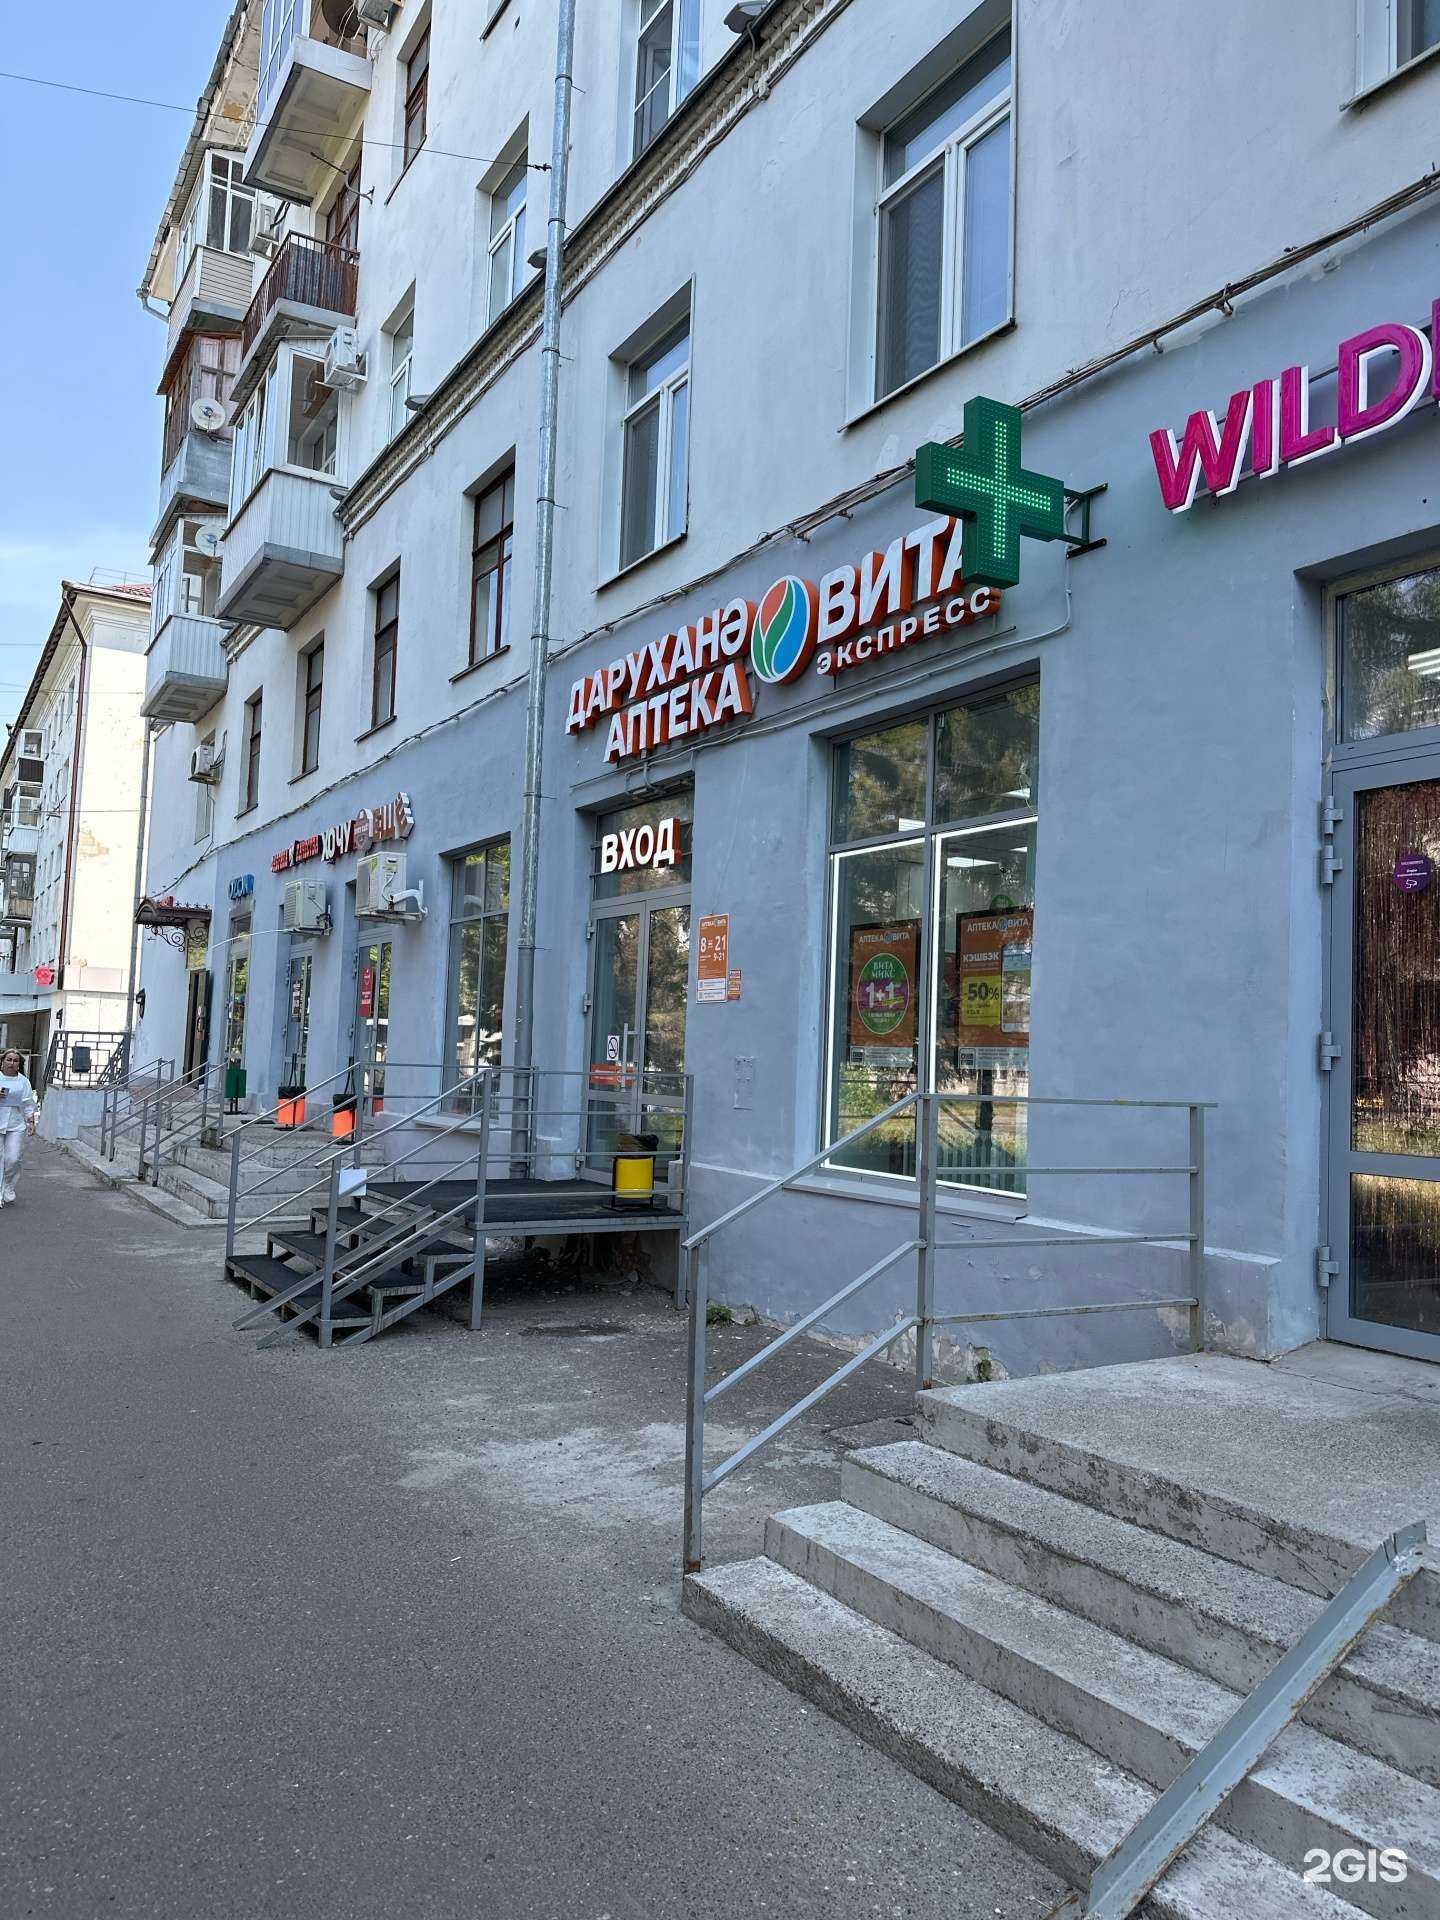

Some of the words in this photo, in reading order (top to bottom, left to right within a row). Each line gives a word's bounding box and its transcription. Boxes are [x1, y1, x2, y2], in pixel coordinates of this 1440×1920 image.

[1149, 297, 1440, 512] WILD
[565, 597, 749, 735] ДАРУХАНӘ
[816, 586, 991, 675] ЭКСПРЕСС
[602, 663, 744, 763] АПТЕКА
[600, 817, 676, 874] ВХОД
[963, 952, 999, 963] КЭШБЭК
[967, 920, 997, 932] АПТЕКА
